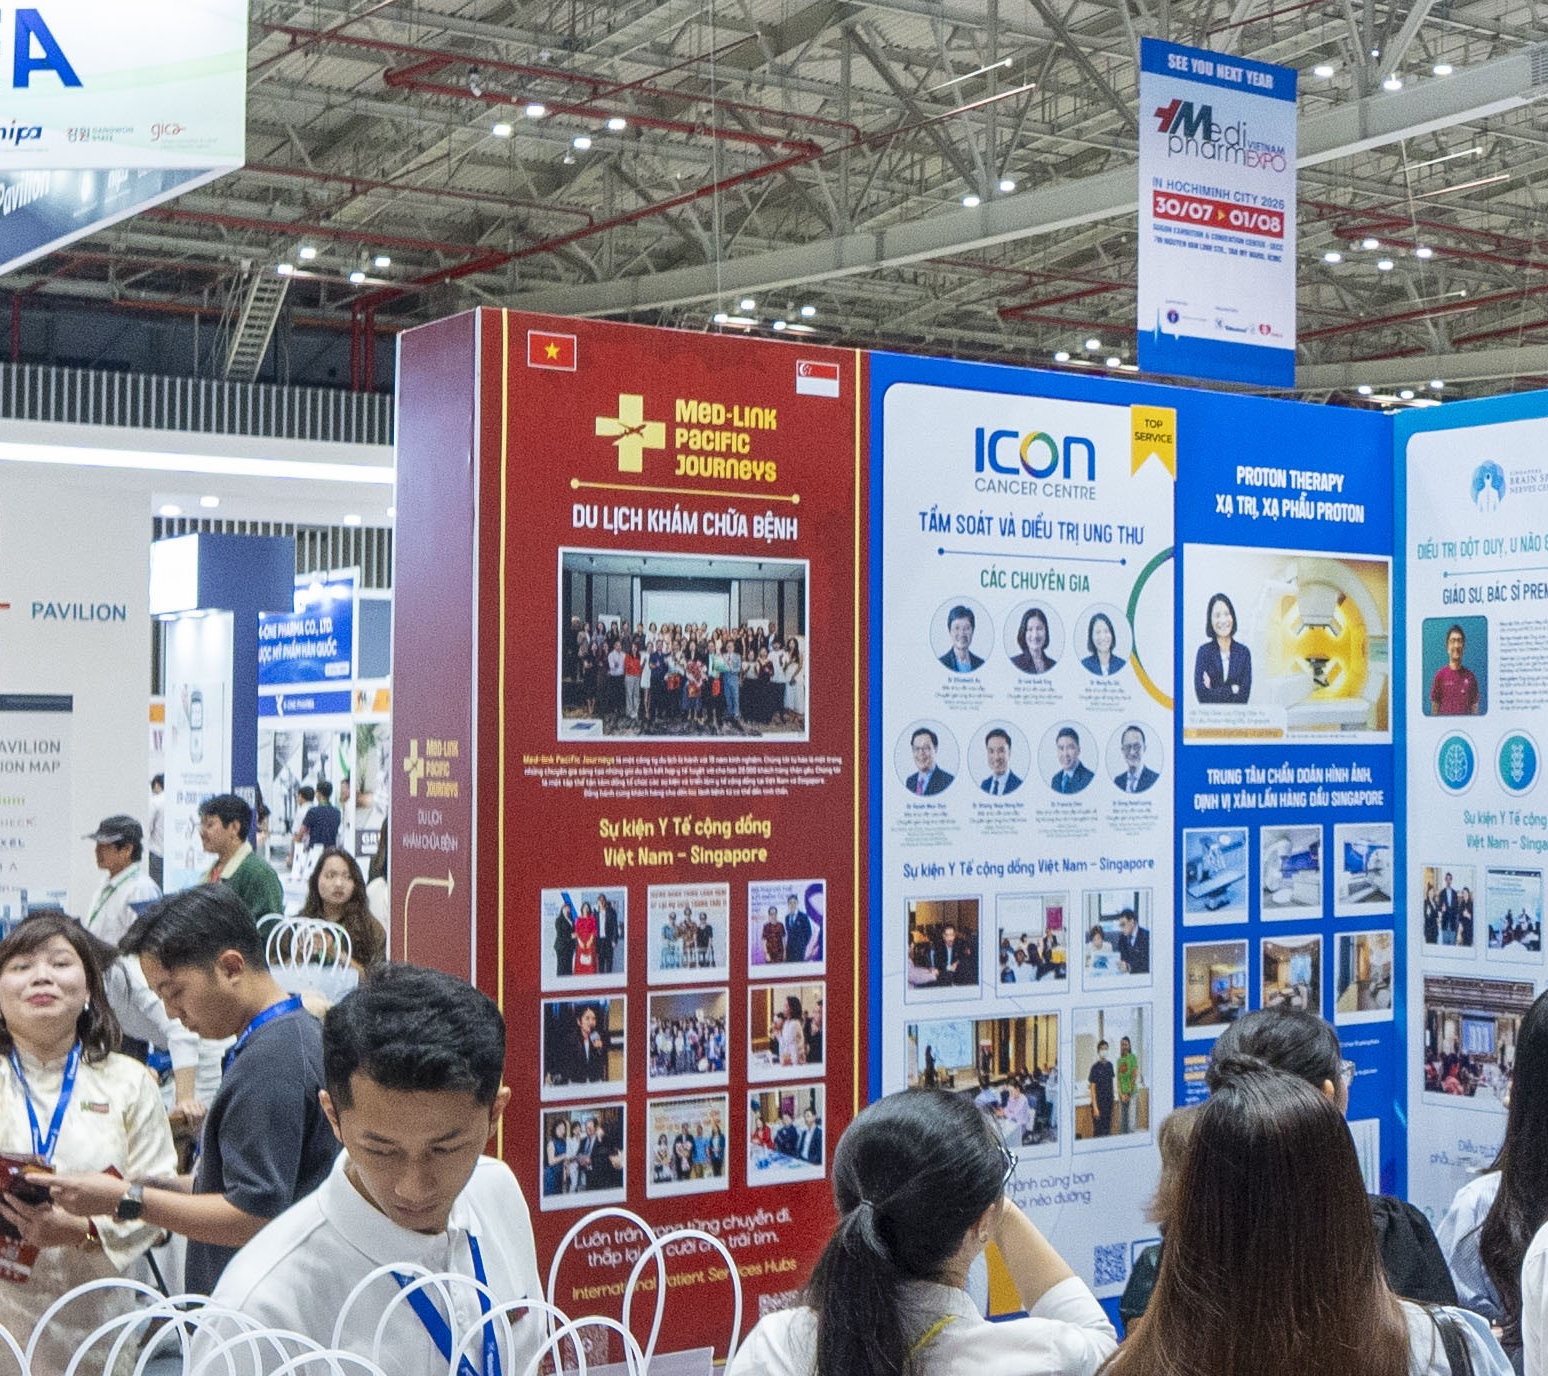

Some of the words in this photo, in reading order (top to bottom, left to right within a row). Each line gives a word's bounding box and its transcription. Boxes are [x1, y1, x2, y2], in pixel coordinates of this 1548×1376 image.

[1168, 53, 1188, 69] SEE
[1192, 57, 1213, 75] YOU
[1217, 62, 1243, 82] NEXT
[1246, 69, 1274, 89] YEAR
[1172, 102, 1247, 147] Medi
[1168, 134, 1247, 165] pharm
[1247, 140, 1285, 155] VIETNAM
[1247, 150, 1286, 172] EXPO
[1153, 176, 1162, 188] IN
[1167, 180, 1230, 199] HOCHIMINH
[1234, 191, 1258, 204] CITY
[1156, 197, 1213, 221] 30/07
[1229, 210, 1281, 232] 01/08
[1144, 418, 1163, 429] TOP
[1134, 431, 1172, 444] SERVICE
[975, 478, 1039, 497] CANCER
[1042, 482, 1096, 500] CENTRE
[1237, 466, 1286, 488] PROTON
[1290, 469, 1344, 492] THERAPY
[573, 504, 598, 529] DU
[603, 507, 641, 538] LỊCH
[648, 505, 698, 535] KHÁM
[702, 507, 747, 538] CHỮA
[752, 511, 798, 543] BỆNH
[956, 512, 993, 537] SOÁT
[999, 509, 1016, 538] VÀ
[1058, 518, 1079, 545] TRỊ
[1083, 524, 1113, 543] UNG
[1119, 524, 1144, 545] THƯ
[980, 567, 1006, 591] CÁC
[1010, 567, 1065, 592] CHUYÊN
[1069, 573, 1090, 592] GIA
[32, 603, 126, 621] PAVILION
[30, 761, 60, 774] MAP
